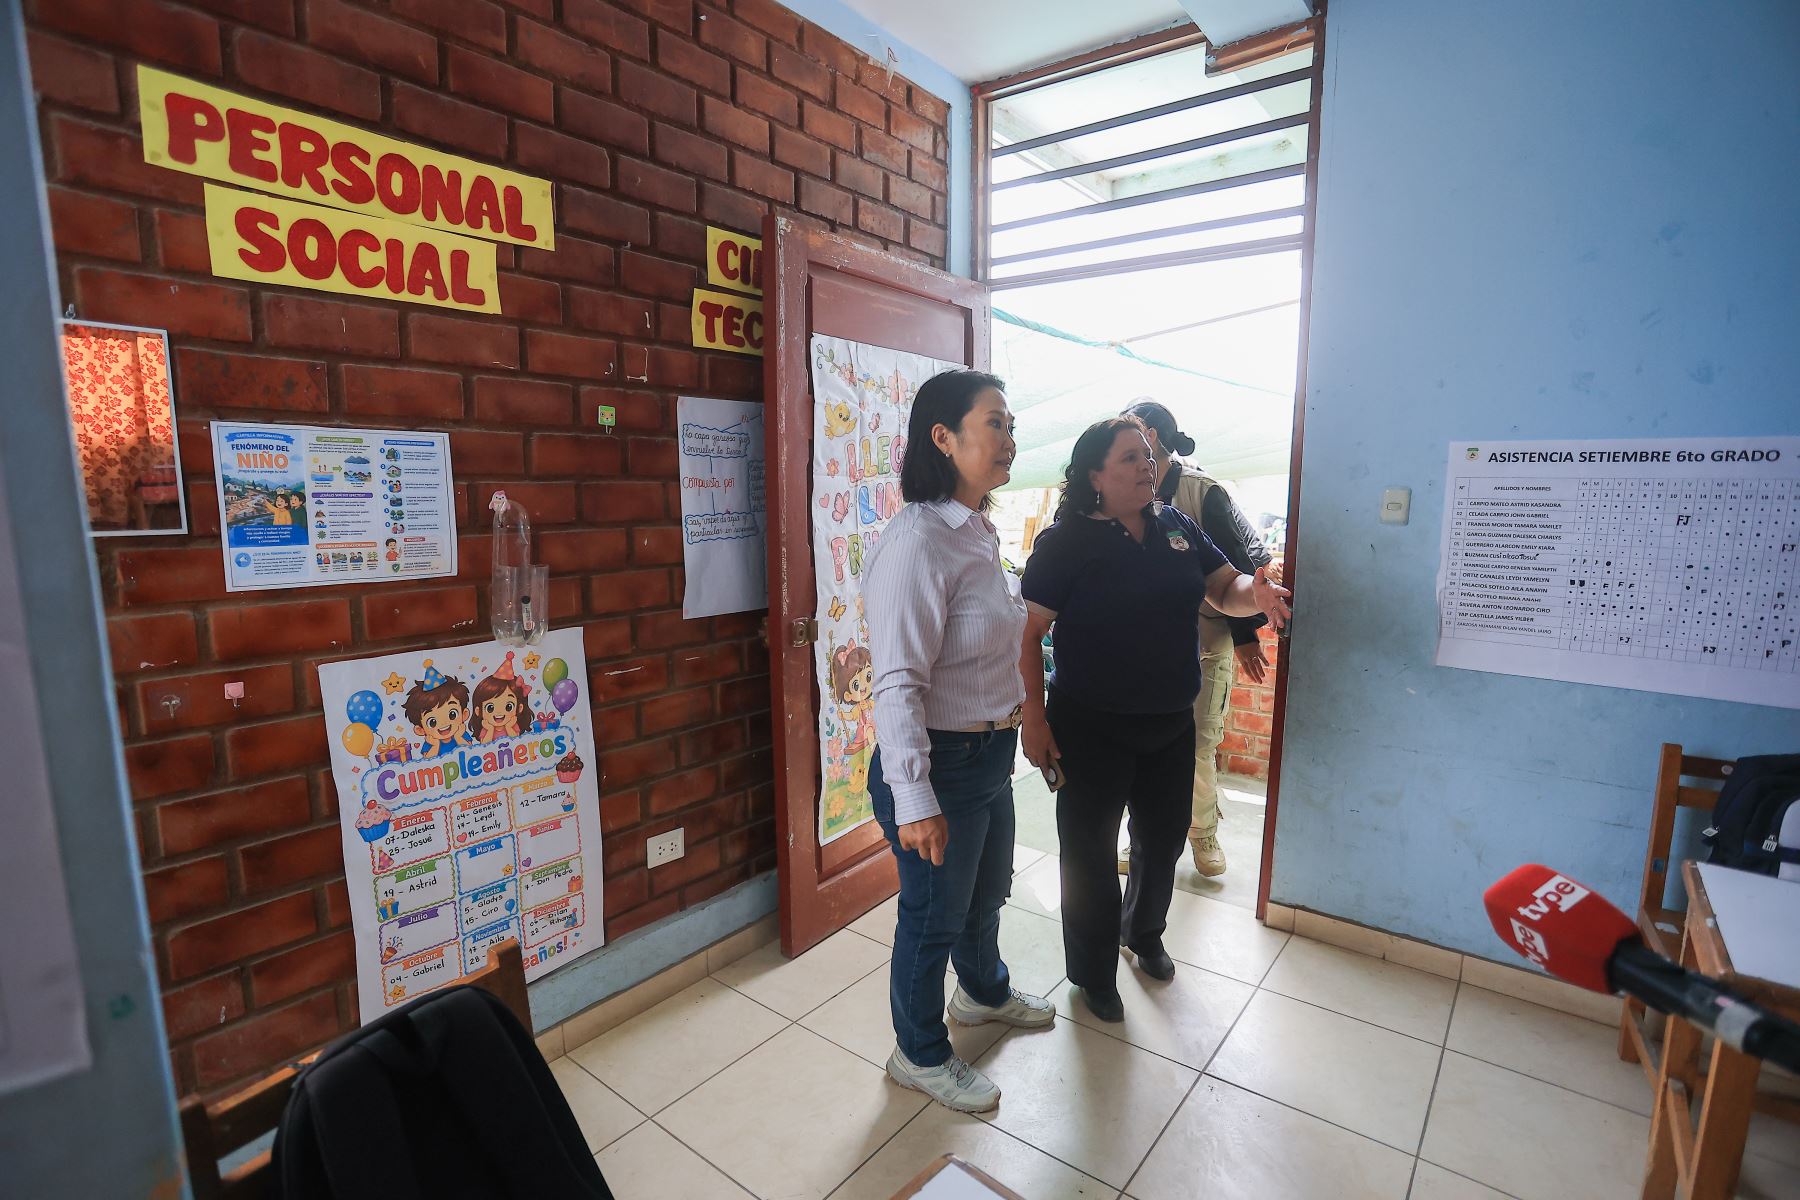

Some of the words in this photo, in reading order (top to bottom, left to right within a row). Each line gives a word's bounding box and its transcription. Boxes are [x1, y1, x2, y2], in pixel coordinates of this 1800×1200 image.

[164, 92, 537, 242] PERSONAL
[234, 207, 486, 306] SOCIAL
[231, 443, 274, 451] FENÓMENO
[276, 444, 290, 452] DEL
[1488, 452, 1574, 462] ASISTENCIA
[1578, 451, 1672, 462] SETIEMBRE
[1676, 450, 1705, 462] 6to
[1710, 450, 1780, 462] GRADO
[237, 450, 289, 469] NIÑO
[376, 735, 567, 800] Cumpleañeros
[466, 796, 493, 808] Febrero
[401, 814, 426, 828] Enero
[476, 844, 496, 856] Mayo
[406, 866, 425, 879] Abril
[408, 876, 438, 894] Astrid
[1516, 880, 1577, 921] tvpe
[408, 912, 428, 925] Julio
[408, 951, 438, 968] Octubre
[412, 960, 446, 978] Gabriel
